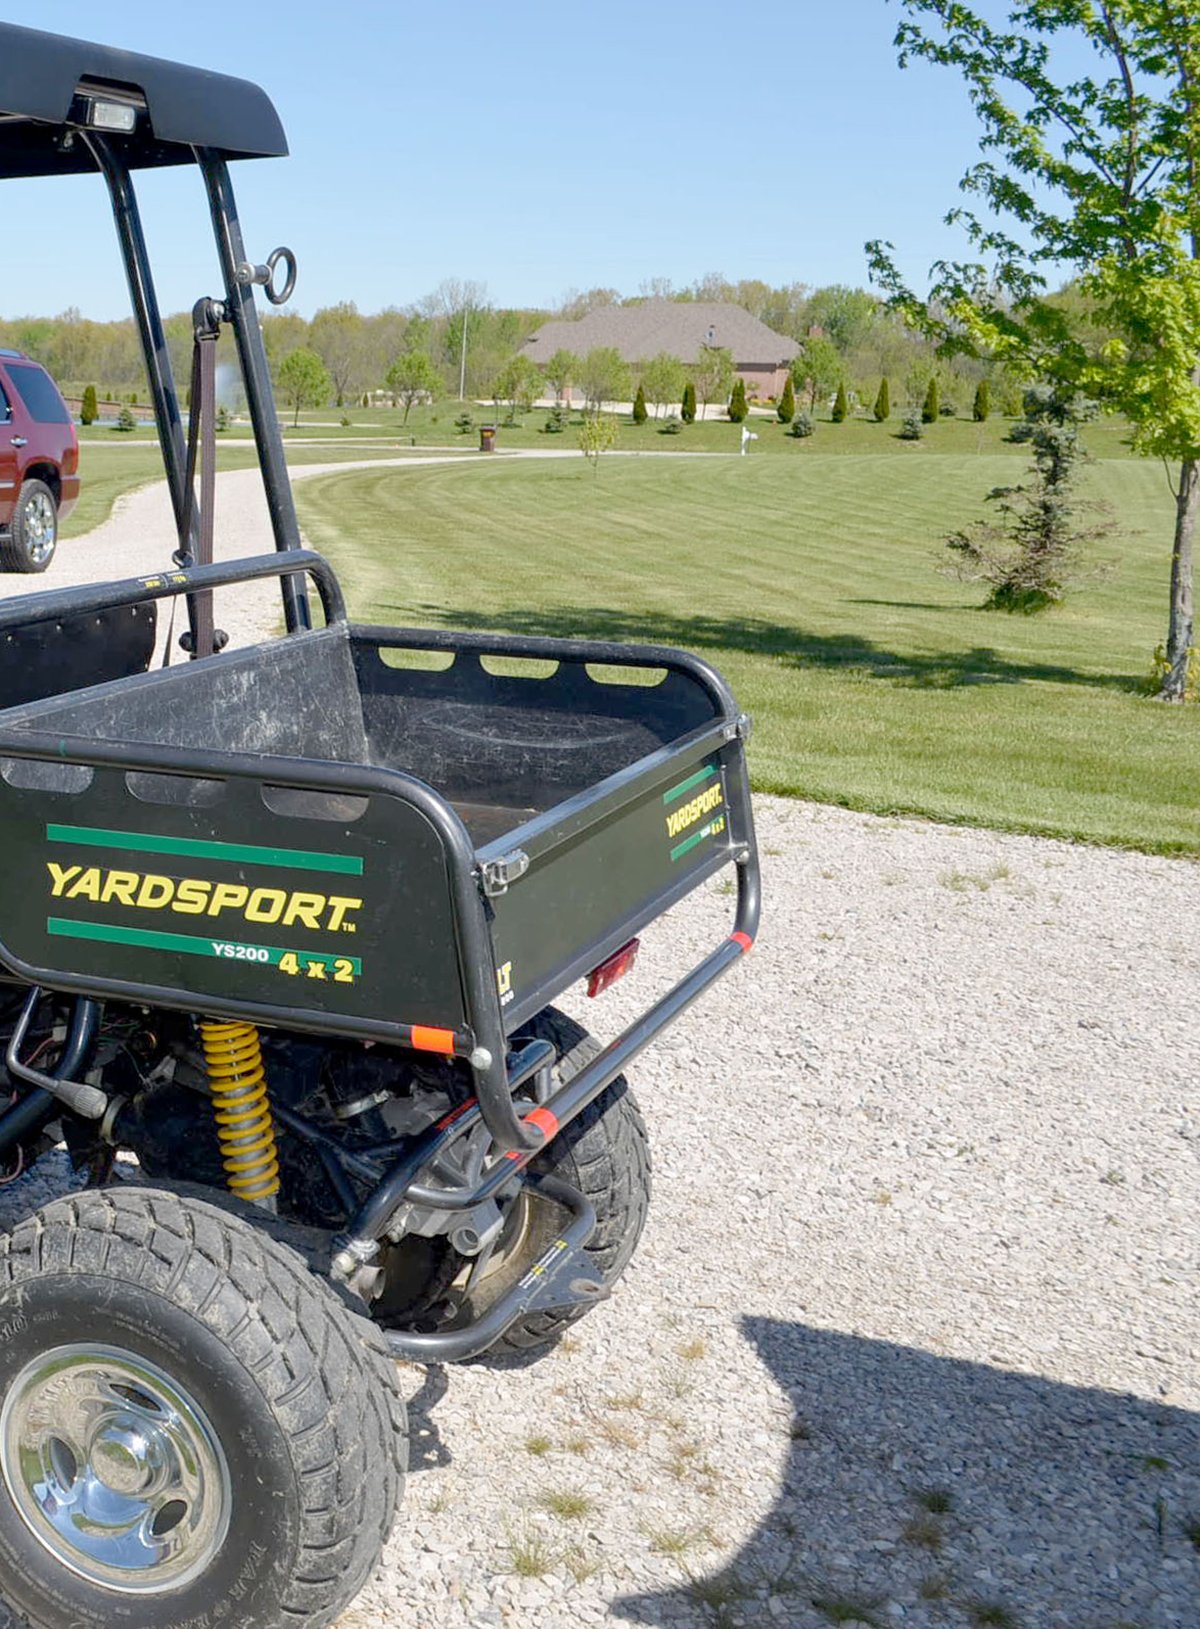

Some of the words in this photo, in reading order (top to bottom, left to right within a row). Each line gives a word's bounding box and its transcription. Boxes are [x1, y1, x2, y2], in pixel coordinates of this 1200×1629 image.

[666, 783, 722, 836] YARDSPORT
[47, 862, 363, 932] YARDSPORT
[212, 942, 270, 963] YS200
[278, 951, 299, 976] 4
[306, 961, 326, 979] x
[332, 959, 354, 983] 2
